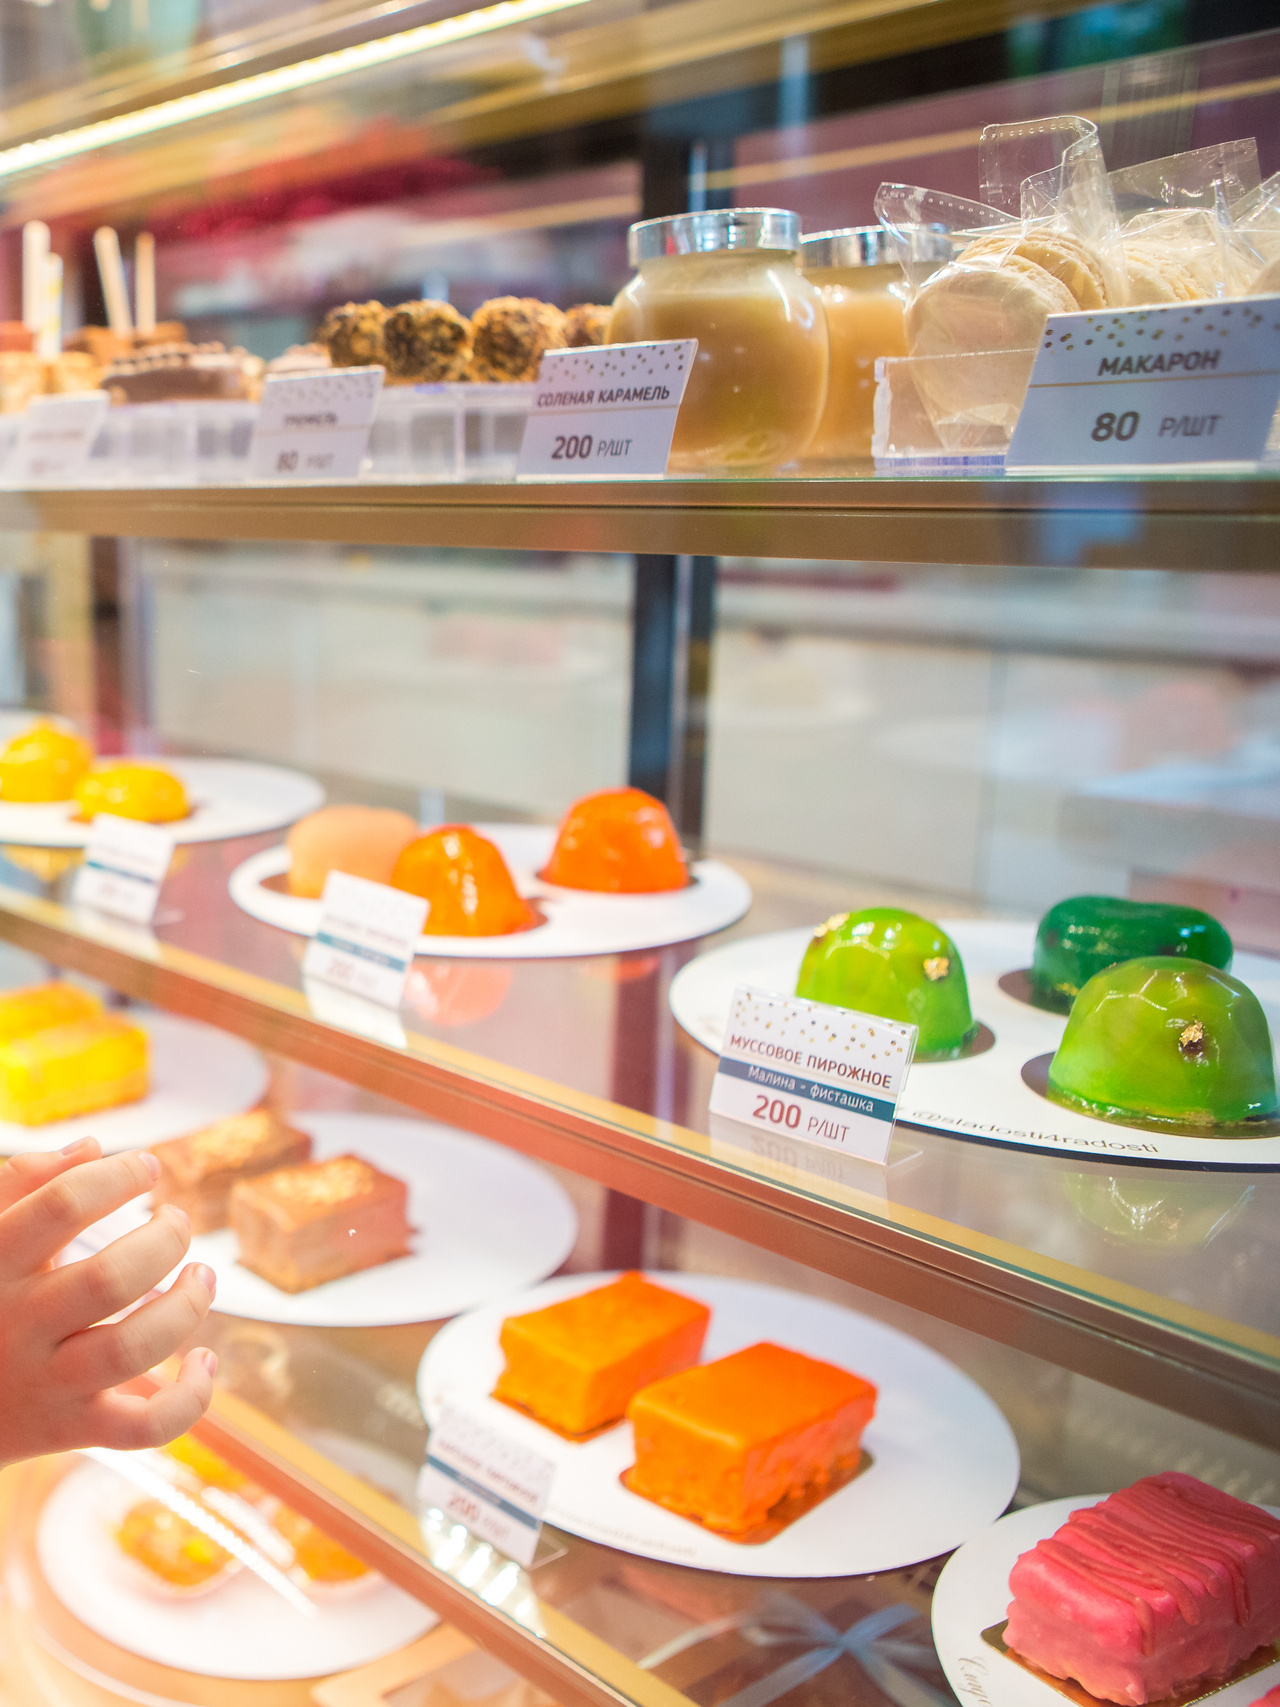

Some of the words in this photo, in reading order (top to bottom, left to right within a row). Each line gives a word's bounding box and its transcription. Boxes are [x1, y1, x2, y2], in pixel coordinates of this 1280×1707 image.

[1097, 349, 1221, 377] МАКАРОН
[537, 390, 595, 408] СОЛЕНАЯ
[598, 385, 670, 405] КАРАМЕЛЬ
[1091, 411, 1140, 442] 80
[1158, 414, 1222, 438] Р/ШТ
[551, 434, 594, 460] 200
[597, 439, 633, 457] Р/ШТ
[730, 1034, 803, 1065] МУССОВОЕ
[806, 1054, 892, 1089] ПИРОЖНОЕ
[748, 1065, 796, 1091] Малина
[810, 1082, 874, 1113] фисташка
[752, 1094, 802, 1130] 200
[807, 1116, 851, 1143] Р/ШТ
